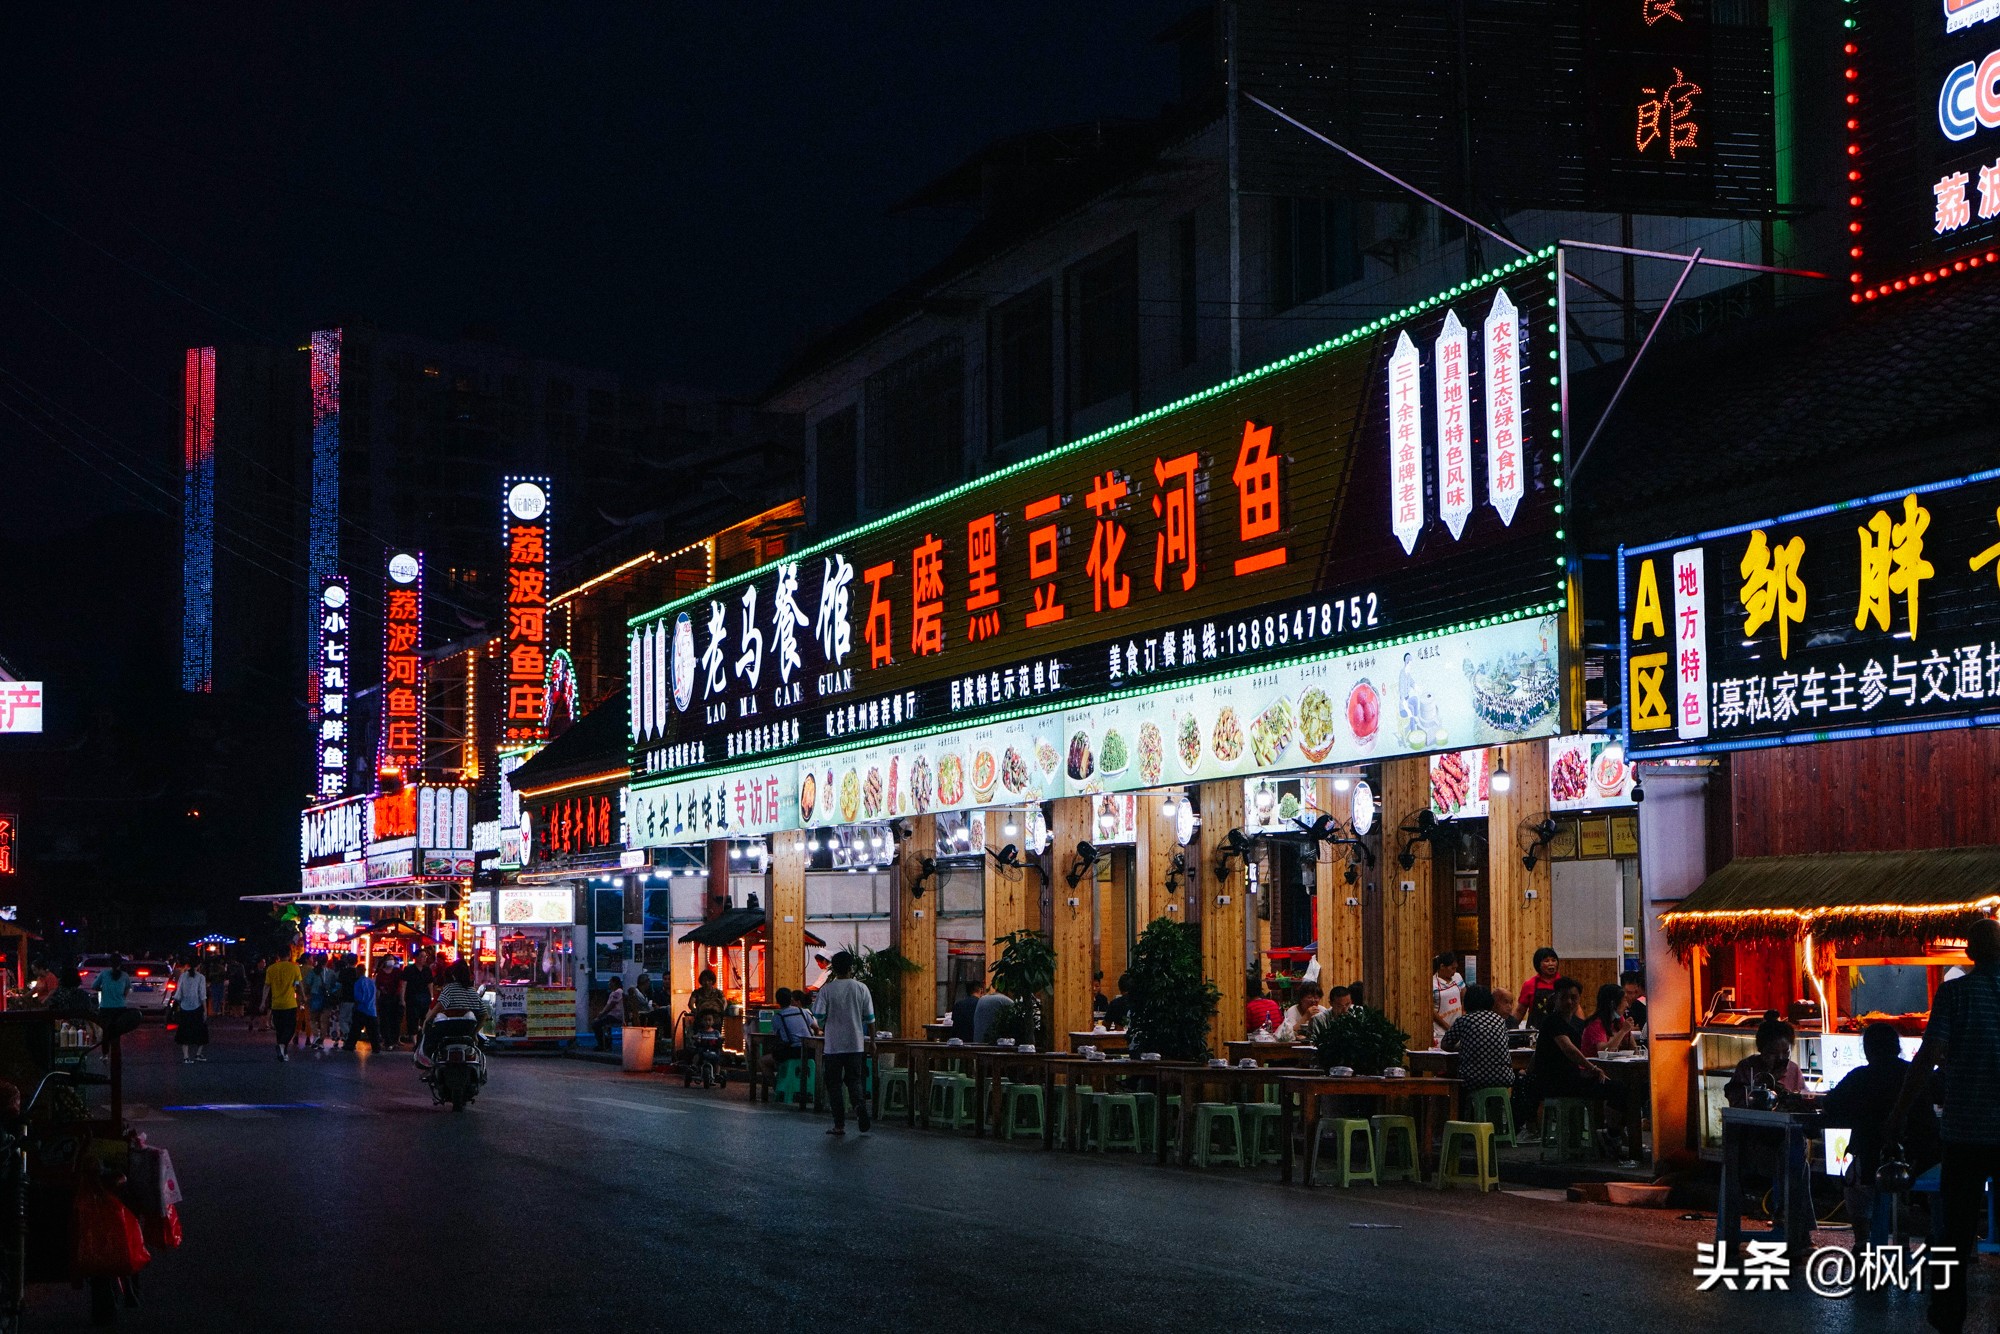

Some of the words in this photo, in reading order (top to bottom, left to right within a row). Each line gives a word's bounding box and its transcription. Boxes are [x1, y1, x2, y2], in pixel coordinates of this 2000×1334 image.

[1636, 0, 1702, 159] 館
[1396, 361, 1417, 523] 三十余年金牌老店
[1443, 341, 1466, 507] 独具地方特色风味
[1491, 321, 1515, 493] 农家生态绿色食材
[508, 525, 546, 719] 荔波河鱼庄
[864, 418, 1287, 670] 石磨黑豆花河鱼
[1740, 492, 2000, 661] 邹胖
[0, 684, 41, 729] 产
[322, 612, 345, 796] 小七孔河鲜鱼庄
[386, 590, 418, 750] 荔波河鱼庄
[702, 553, 854, 700] 老马餐馆
[706, 701, 727, 725] LAO
[740, 694, 758, 717] MA
[775, 682, 801, 707] CAN
[818, 668, 852, 696] GUAN
[950, 657, 1062, 709] 民族特色示范单位
[1678, 562, 1702, 727] 地方特色
[1713, 641, 2000, 729] 募私家车主参与交通
[826, 690, 916, 737] 吃在贵州推荐餐厅
[734, 774, 778, 828] 专访店
